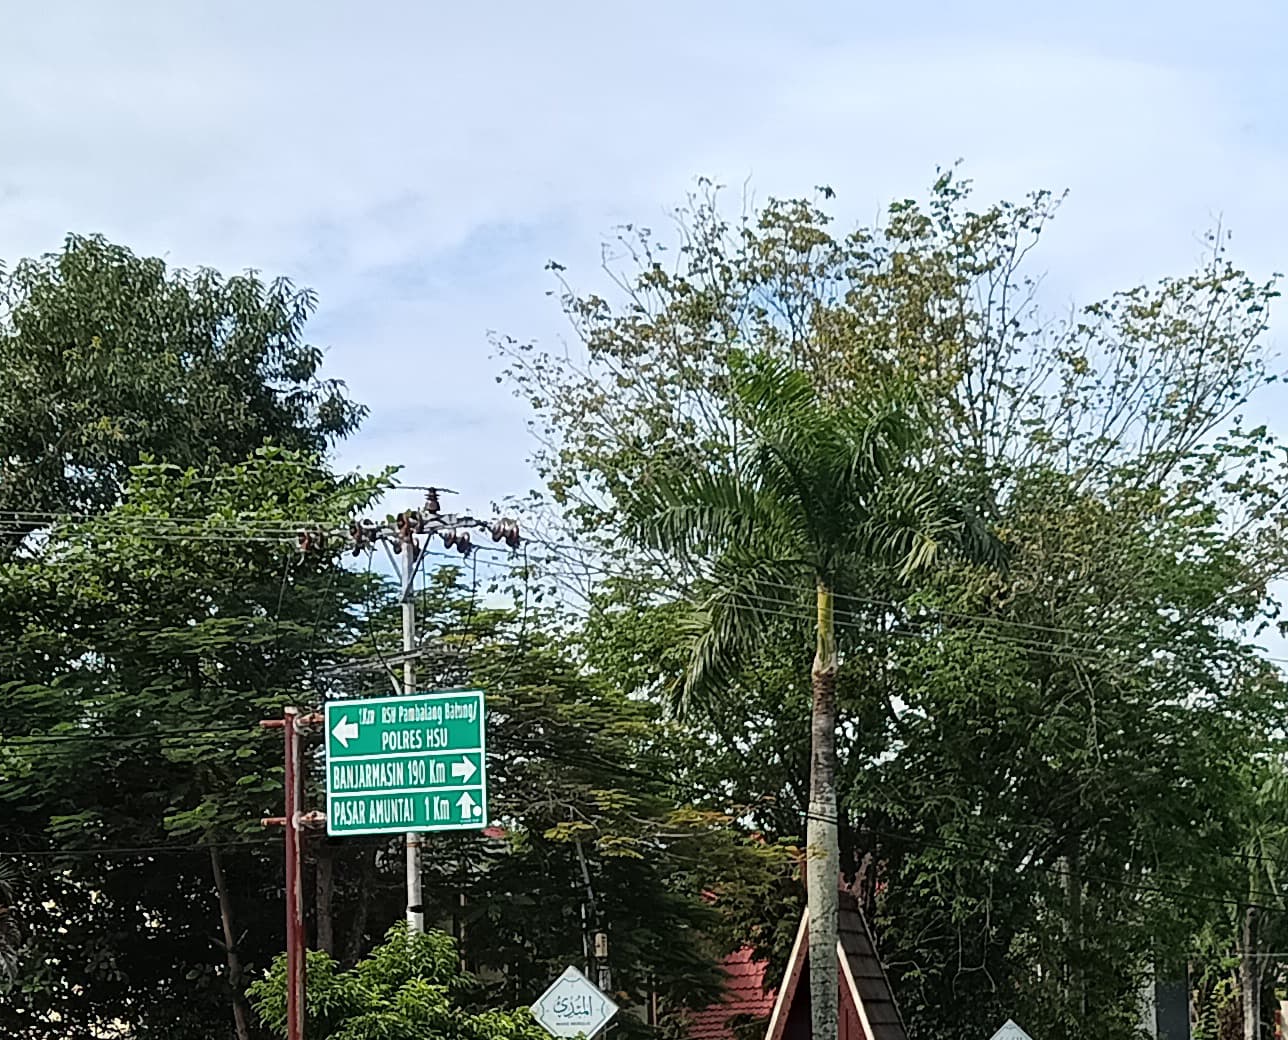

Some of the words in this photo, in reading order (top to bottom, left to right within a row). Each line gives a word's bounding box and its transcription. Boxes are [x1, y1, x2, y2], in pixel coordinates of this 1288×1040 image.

[381, 729, 423, 751] POLRES
[426, 727, 448, 748] HSU
[333, 762, 404, 790] BANJARMASIN
[407, 759, 426, 786] 190
[429, 759, 446, 784] Km
[333, 800, 366, 826] PASAR
[369, 798, 414, 824] AMUNTAI
[424, 796, 430, 821] 1
[433, 795, 450, 821] Km
